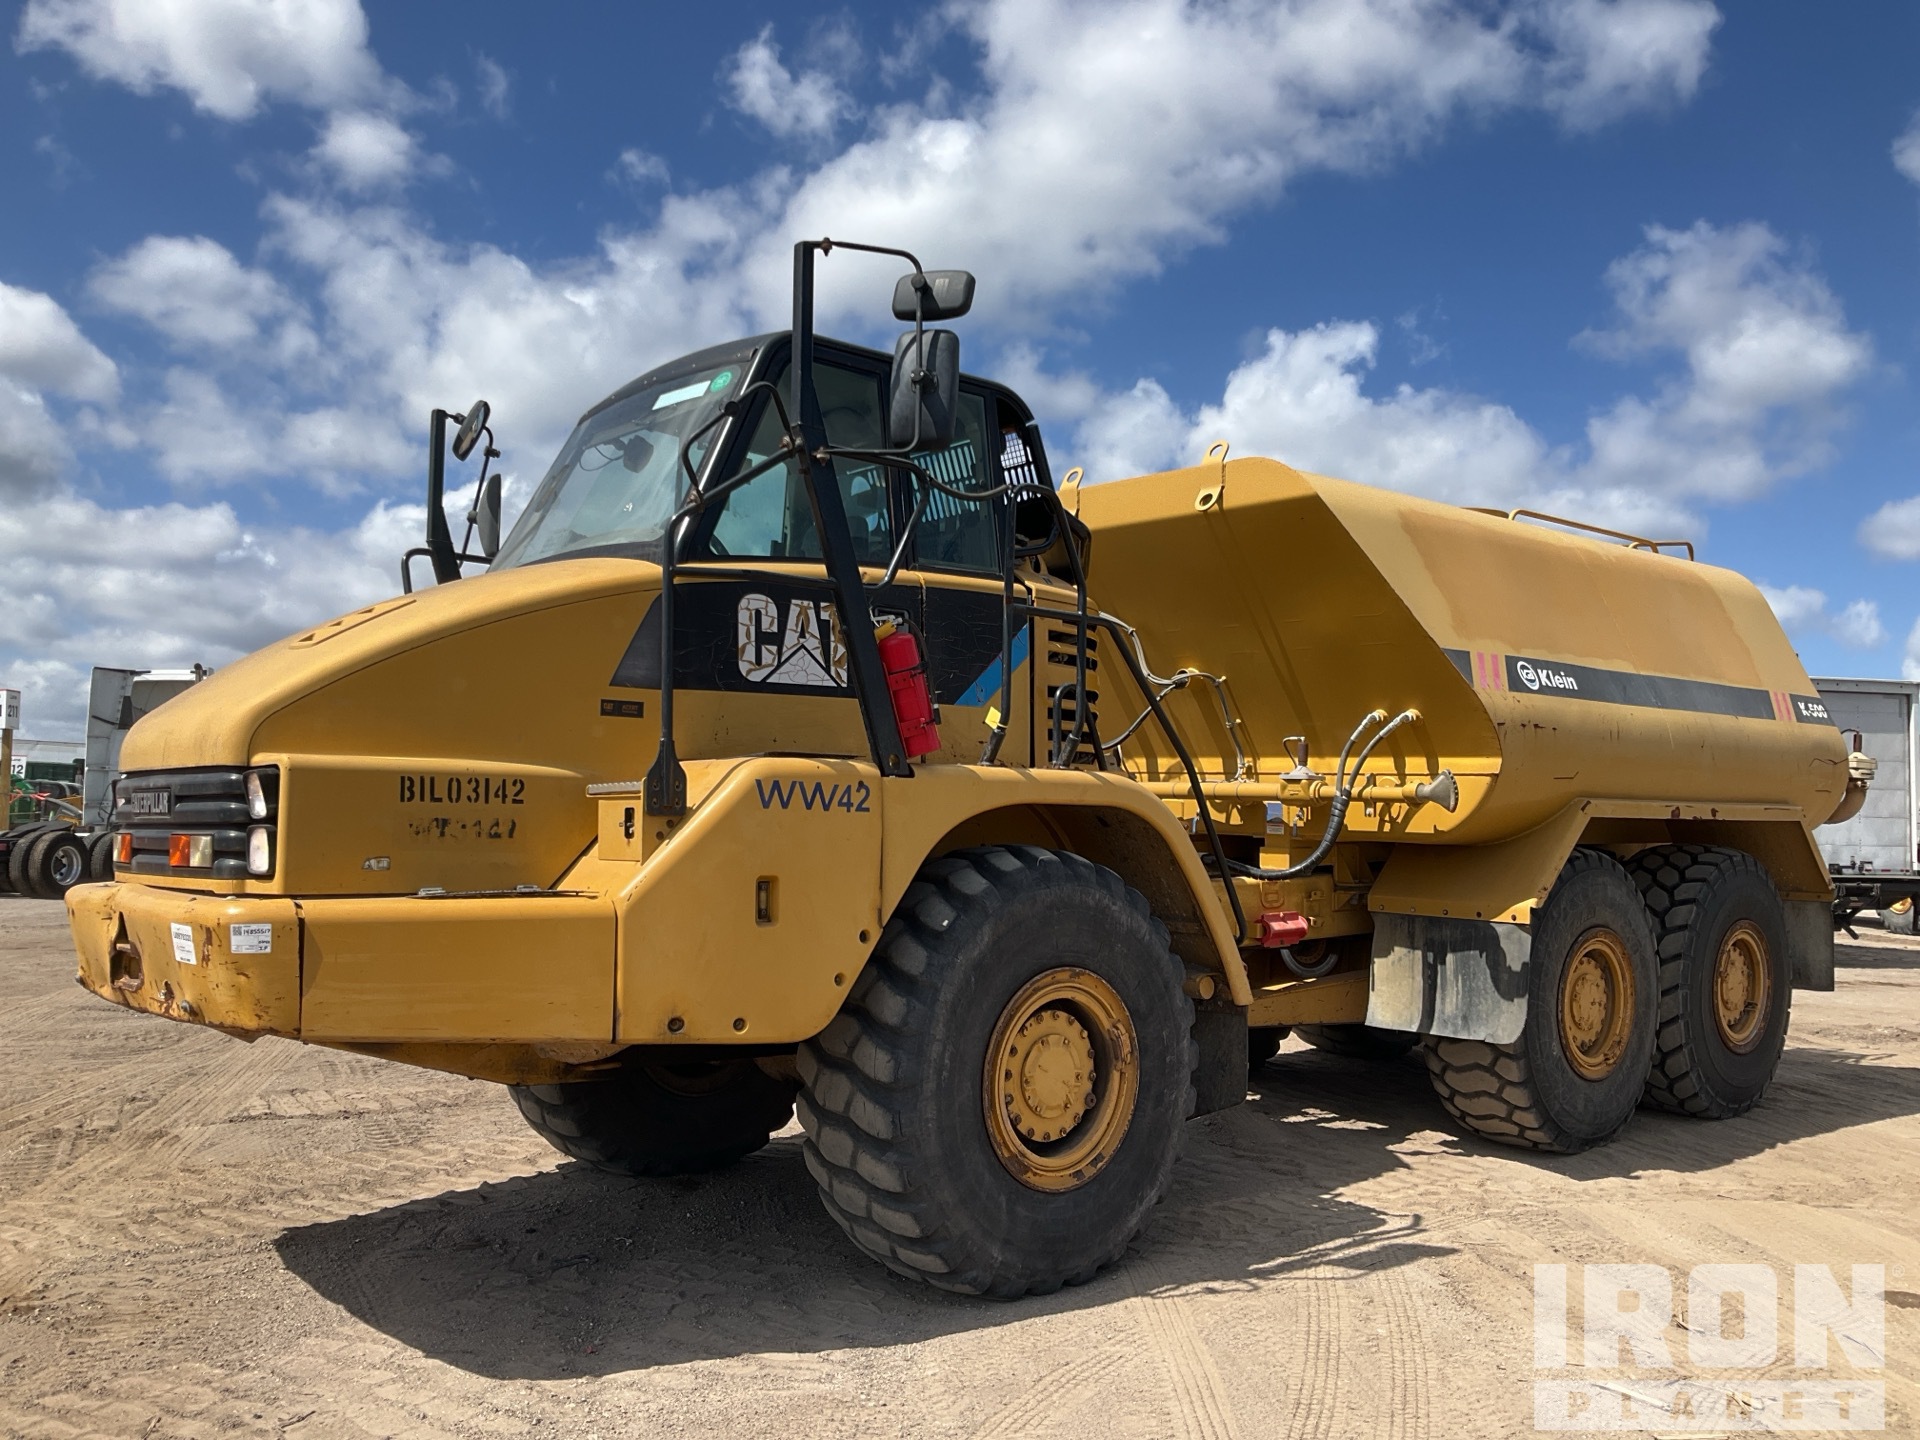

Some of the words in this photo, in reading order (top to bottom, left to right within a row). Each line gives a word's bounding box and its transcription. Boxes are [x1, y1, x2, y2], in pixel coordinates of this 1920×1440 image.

[1536, 668, 1579, 690] Klein
[7, 704, 19, 719] 211
[12, 764, 24, 774] 12
[755, 779, 871, 813] WW42
